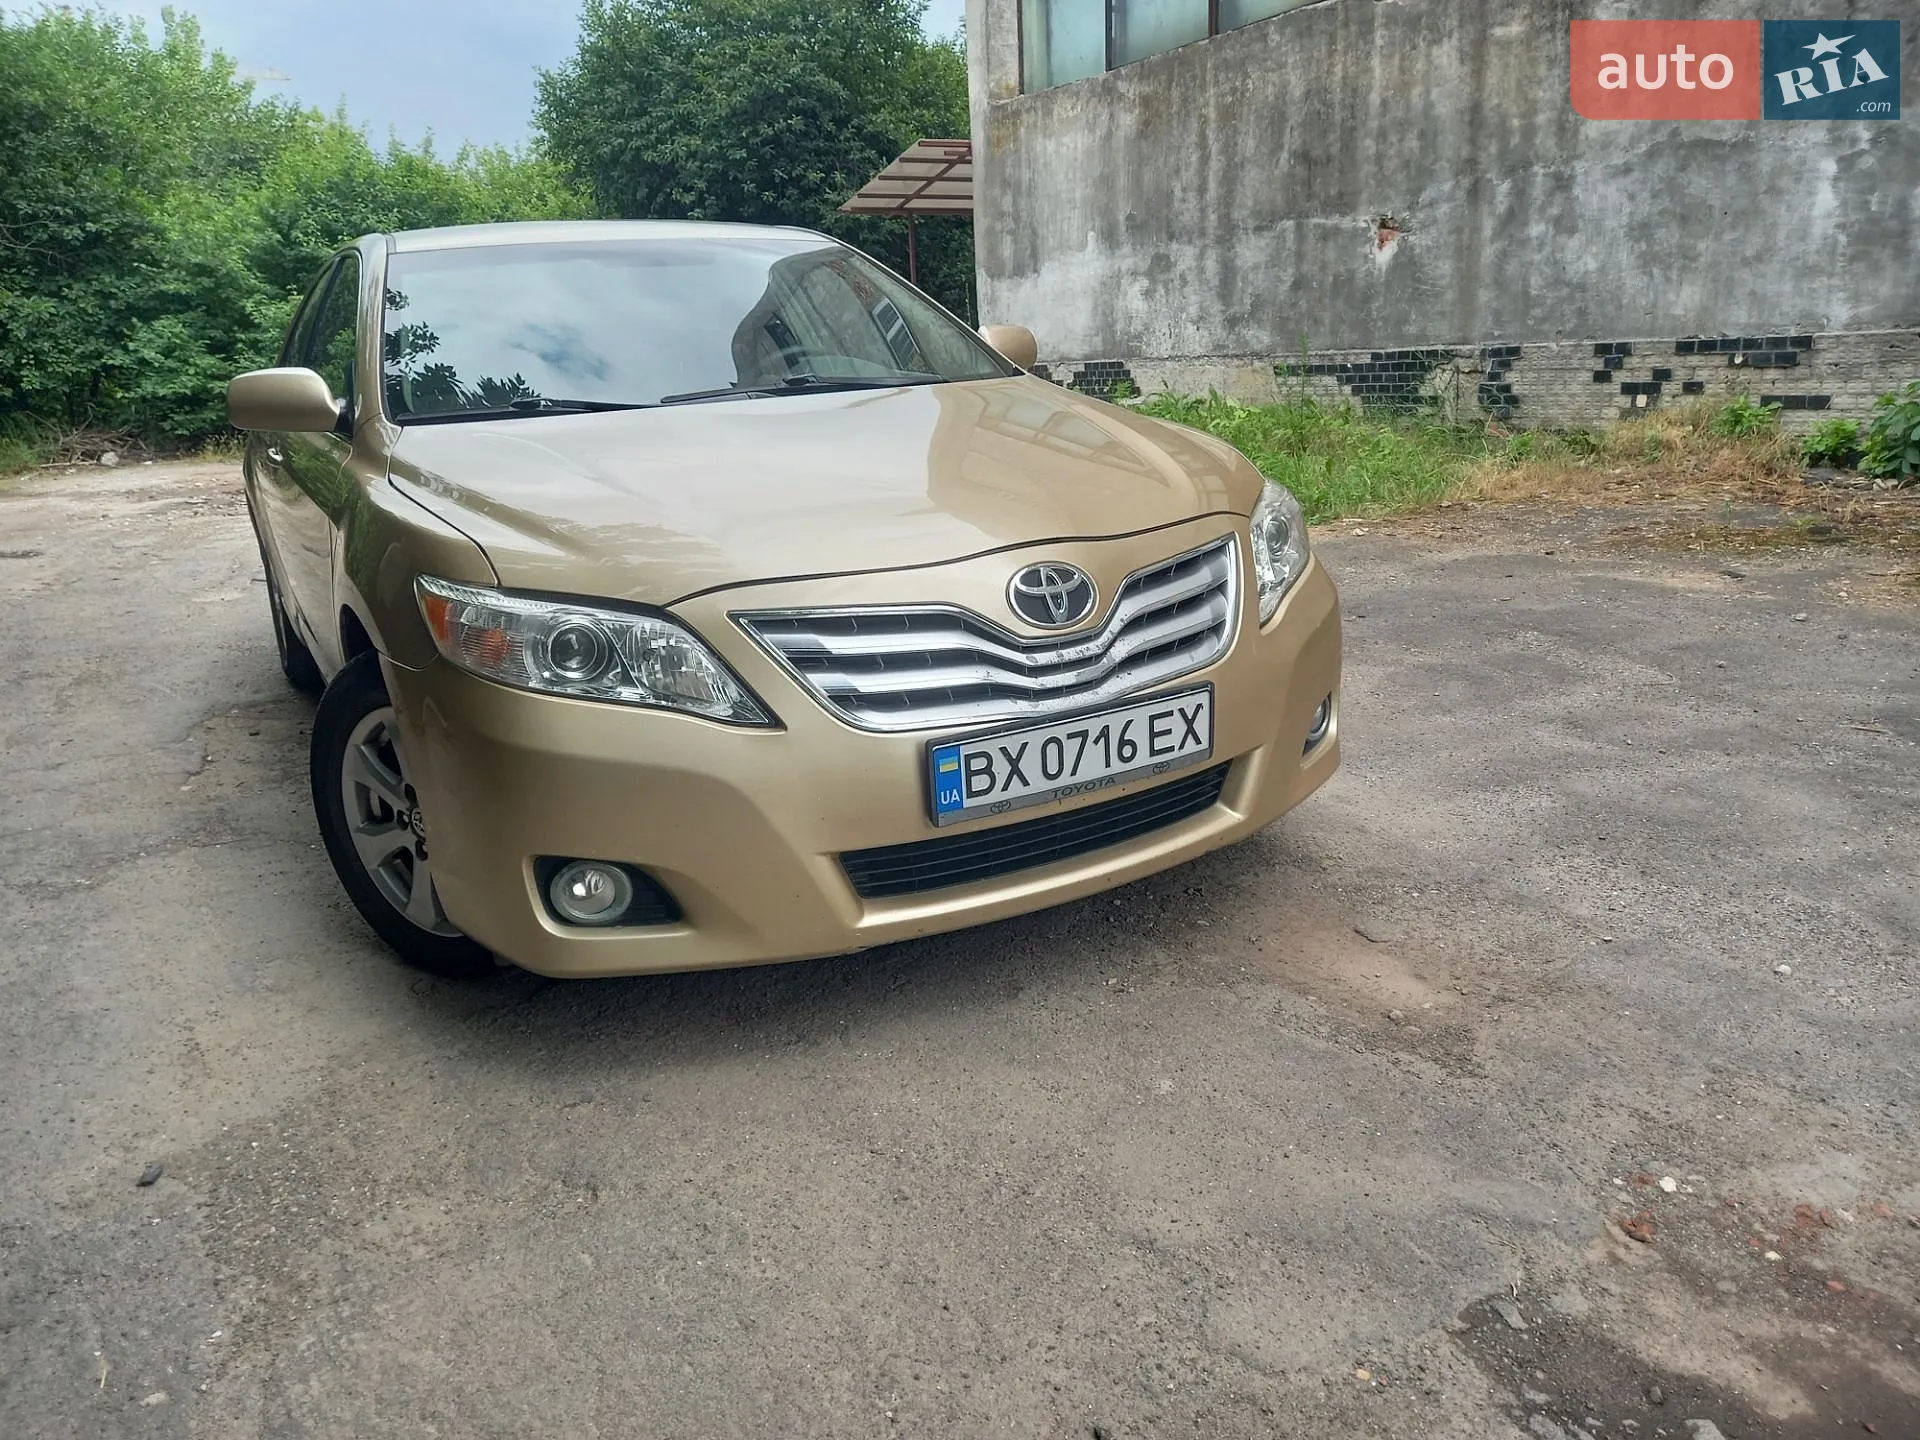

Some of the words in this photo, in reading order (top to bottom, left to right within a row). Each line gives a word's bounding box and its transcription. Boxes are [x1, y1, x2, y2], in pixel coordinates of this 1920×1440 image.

[964, 741, 1031, 799] BX
[1041, 719, 1138, 780] 0716
[1148, 703, 1204, 757] EX
[940, 790, 961, 804] UA
[1051, 776, 1116, 799] TOYOTA
